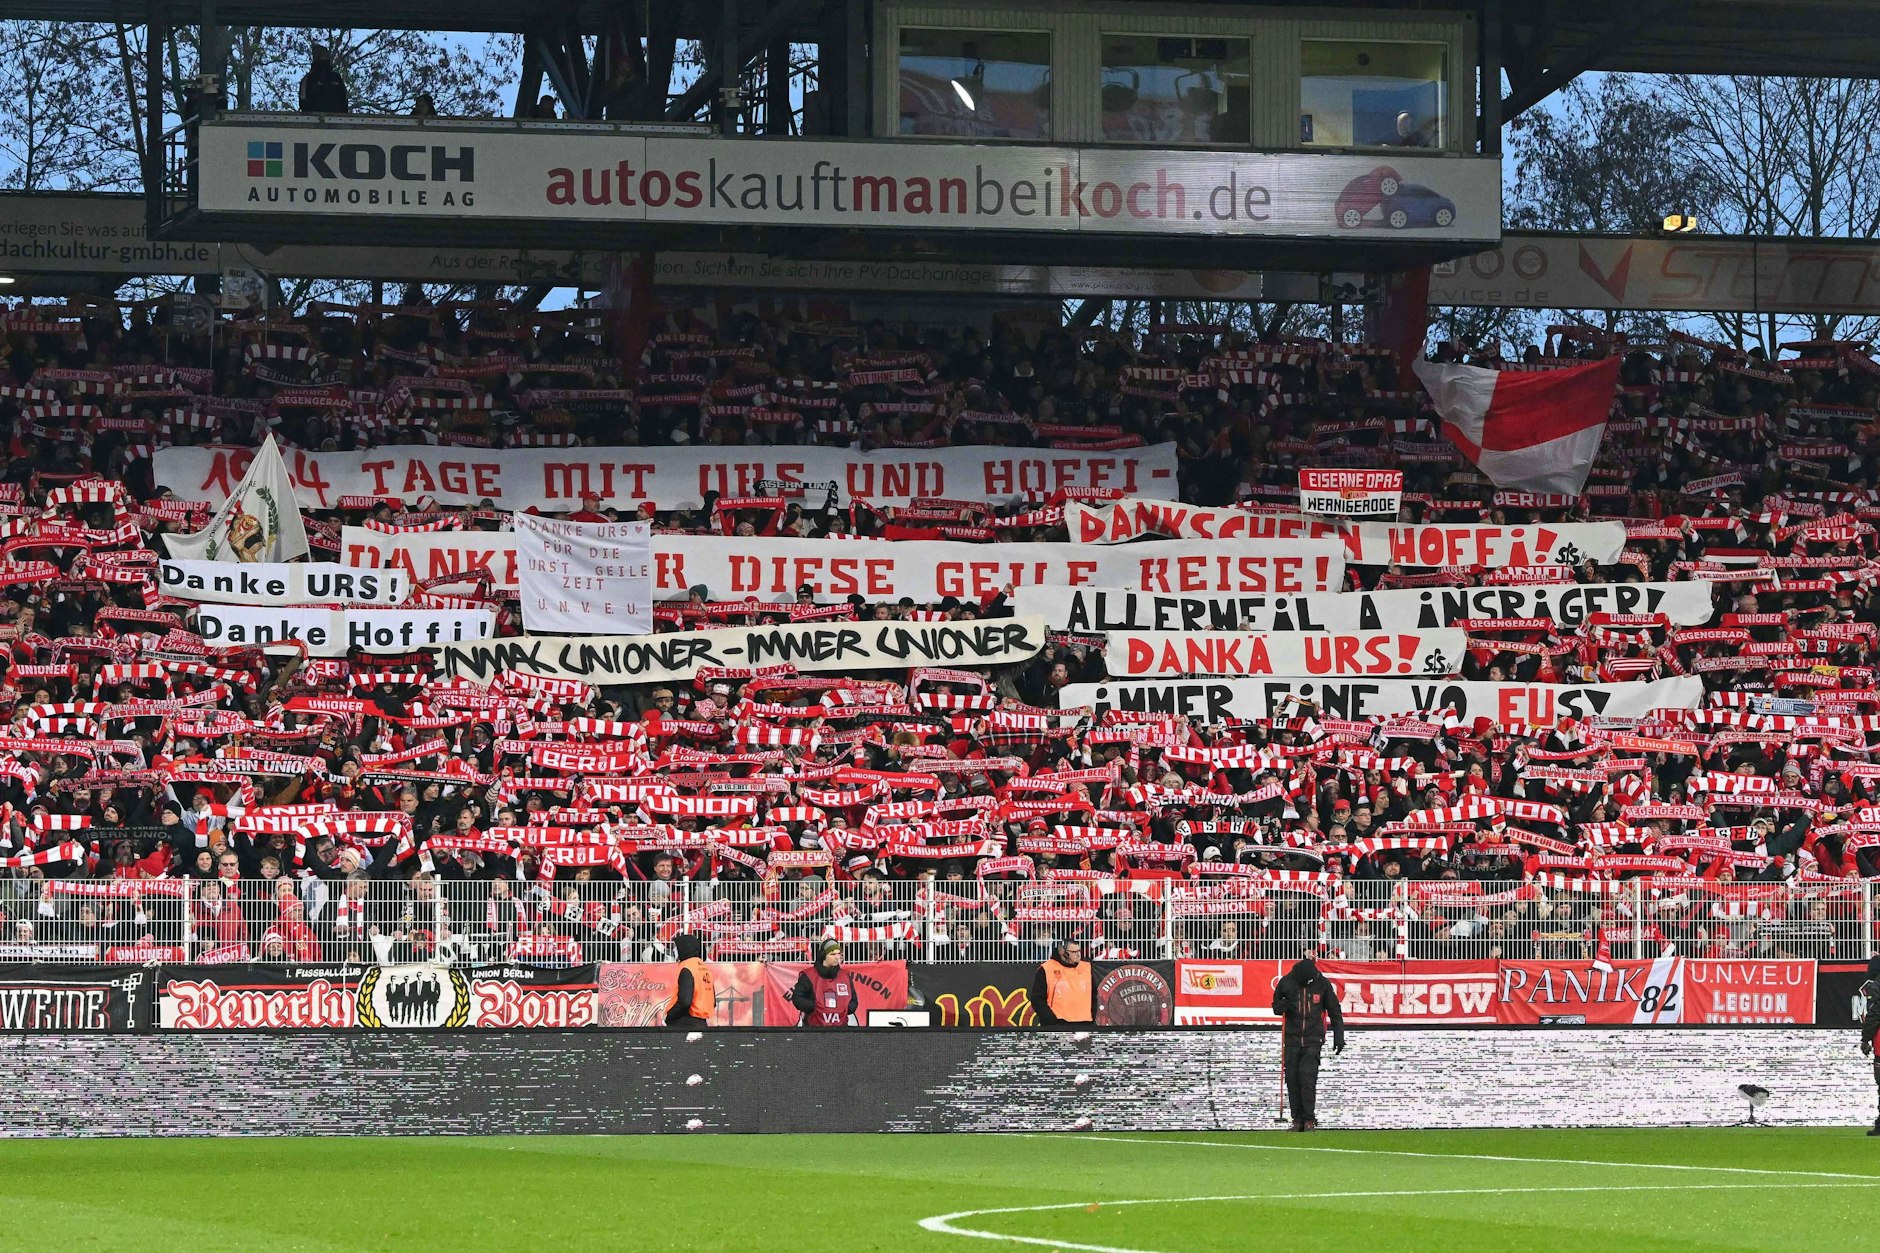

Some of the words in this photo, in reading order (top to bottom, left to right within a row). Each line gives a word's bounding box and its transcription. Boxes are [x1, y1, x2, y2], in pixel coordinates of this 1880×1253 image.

[293, 143, 474, 183] KOCH
[545, 158, 1271, 221] autoskauftmanbeikoch.de
[248, 188, 428, 206] AUTOMOBILE
[443, 191, 475, 207] AG
[60, 221, 83, 235] Sie
[87, 225, 118, 236] was
[122, 222, 147, 238] auf
[0, 239, 209, 263] dachkultur-gmbh.de
[430, 256, 460, 270] Aus
[464, 257, 495, 270] der
[694, 261, 753, 275] Sichern
[760, 262, 781, 277] Sie
[787, 263, 818, 277] sich
[824, 263, 854, 278] Ihre
[858, 264, 992, 284] PV-Dachanlage
[101, 418, 145, 429] UNIONER
[1786, 446, 1842, 457] UNIONER
[201, 448, 330, 507] 14
[361, 458, 502, 497] TAGE
[544, 462, 656, 500] MIT
[846, 462, 944, 497] UND
[983, 458, 1170, 495] HOFFI-
[1309, 472, 1363, 488] EISERNE
[1366, 472, 1402, 488] OPAS
[1685, 478, 1713, 493] EISERN
[1715, 473, 1742, 487] UNION
[80, 480, 111, 490] Union
[1064, 486, 1113, 498] UNIONER
[160, 500, 206, 511] UNIONER
[746, 496, 783, 504] MITGLIEDER!
[1307, 498, 1395, 513] WERNIGERODE
[529, 518, 583, 536] DANKE
[598, 526, 628, 538] URS
[544, 541, 573, 556] FÜR
[589, 548, 620, 559] DIE
[595, 564, 648, 577] GEILE
[728, 555, 895, 595] DIESE
[1139, 556, 1330, 593] REISE!
[163, 563, 285, 597] Danke
[308, 572, 398, 605] URS!
[563, 577, 605, 589] ZEIT
[801, 606, 832, 616] Union
[1360, 594, 1383, 631] A
[1469, 619, 1546, 628] GEGENGERADE
[1609, 614, 1655, 623] UNIONER
[1738, 614, 1782, 624] UNIONER
[200, 614, 327, 646] Danke
[350, 621, 488, 648] Hoffi!
[1675, 630, 1749, 642] GEGENGERADE
[160, 638, 206, 655] Eisernes
[558, 637, 726, 677] UNIONER
[746, 626, 870, 664] IMMER
[876, 624, 1038, 664] UNIONER
[1749, 643, 1794, 654] UNIONER
[1127, 634, 1274, 675] DANKÄ
[1304, 634, 1421, 675] URS!
[17, 664, 68, 675] UNIONER
[1787, 673, 1836, 686] UNIONER
[186, 689, 217, 702] Berlin
[1820, 692, 1835, 701] FÜR
[112, 704, 144, 712] NIEMALS
[308, 700, 363, 713] UNIONER
[752, 703, 807, 715] UNIONER
[1016, 705, 1048, 714] EISERN
[1051, 708, 1081, 716] UNION
[1412, 686, 1468, 723] VO
[826, 707, 842, 716] FC
[845, 706, 880, 715] Union
[1122, 713, 1135, 722] FC
[1138, 711, 1169, 722] Union
[177, 723, 195, 733] FÜR
[661, 722, 715, 734] UNIONER
[1324, 722, 1352, 733] UNION
[1813, 726, 1836, 735] UNION
[1621, 738, 1636, 746] FC
[1640, 741, 1669, 750] Union
[361, 753, 380, 763] NUR
[382, 752, 399, 762] FÜR
[1613, 759, 1640, 767] UNION
[902, 777, 934, 785] UNIONER
[1057, 771, 1084, 781] UNION
[1012, 779, 1065, 791] UNIONER
[648, 795, 755, 814] UNION
[1714, 794, 1758, 804] EISERN
[1762, 796, 1818, 808] UNION
[1409, 822, 1439, 830] UNION
[1815, 825, 1849, 836] EISERN
[432, 836, 508, 850] UNIONER
[1533, 836, 1551, 848] FÜR
[1669, 837, 1685, 845] WIR
[1687, 837, 1720, 847] UNIONER
[894, 846, 908, 855] FC
[910, 847, 938, 856] UNION
[1606, 857, 1631, 866] SPIELT
[1056, 869, 1072, 879] FÜR
[1477, 890, 1516, 903] UNION
[116, 948, 171, 959] UNIONER
[286, 969, 292, 978] 1.
[295, 966, 362, 980] FUSSBALLCLUB
[472, 969, 500, 979] UNION
[503, 968, 534, 979] BERLIN
[1691, 963, 1808, 985] U.N.V.E.U.
[850, 971, 891, 1000] NION
[1102, 977, 1117, 993] DIE
[1118, 967, 1165, 991] ÜBLICHEN
[1215, 977, 1237, 987] UNION
[1119, 985, 1148, 998] EISERN
[1499, 967, 1645, 1006] PANIK
[1640, 984, 1679, 1013] 82
[168, 979, 355, 1028] Beverly
[472, 980, 593, 1028] Boys
[1123, 994, 1154, 1007] UNION
[1331, 983, 1497, 1015] ANKOW
[1713, 990, 1787, 1013] LEGION
[822, 1013, 840, 1023] VA
